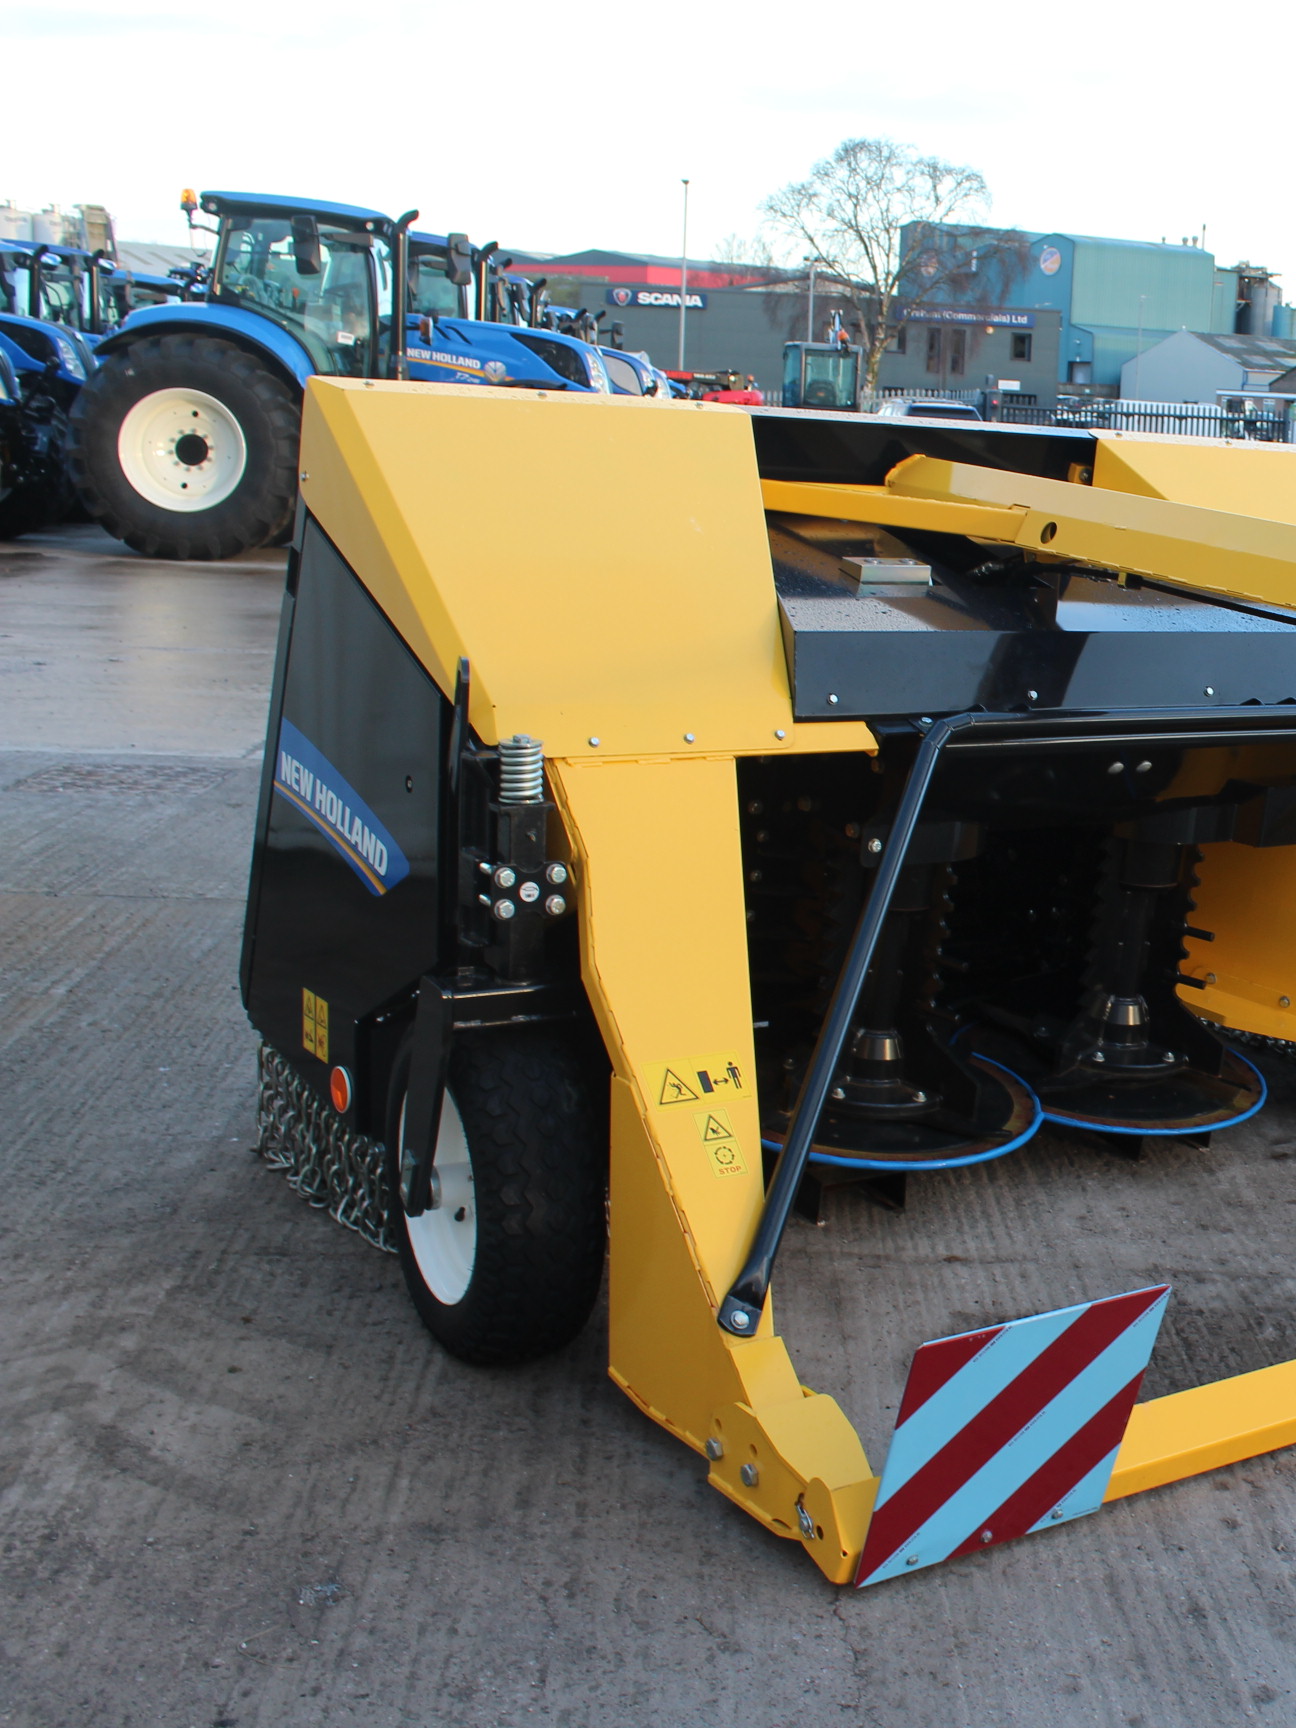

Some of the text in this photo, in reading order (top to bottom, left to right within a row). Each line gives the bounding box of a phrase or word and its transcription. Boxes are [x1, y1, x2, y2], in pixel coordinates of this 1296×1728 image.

[637, 292, 703, 307] SCANIA
[1012, 314, 1028, 324] Ltd
[406, 347, 481, 369] NEW HOLLAND
[281, 750, 388, 877] NEW HOLLAND
[718, 1165, 742, 1175] STOP
